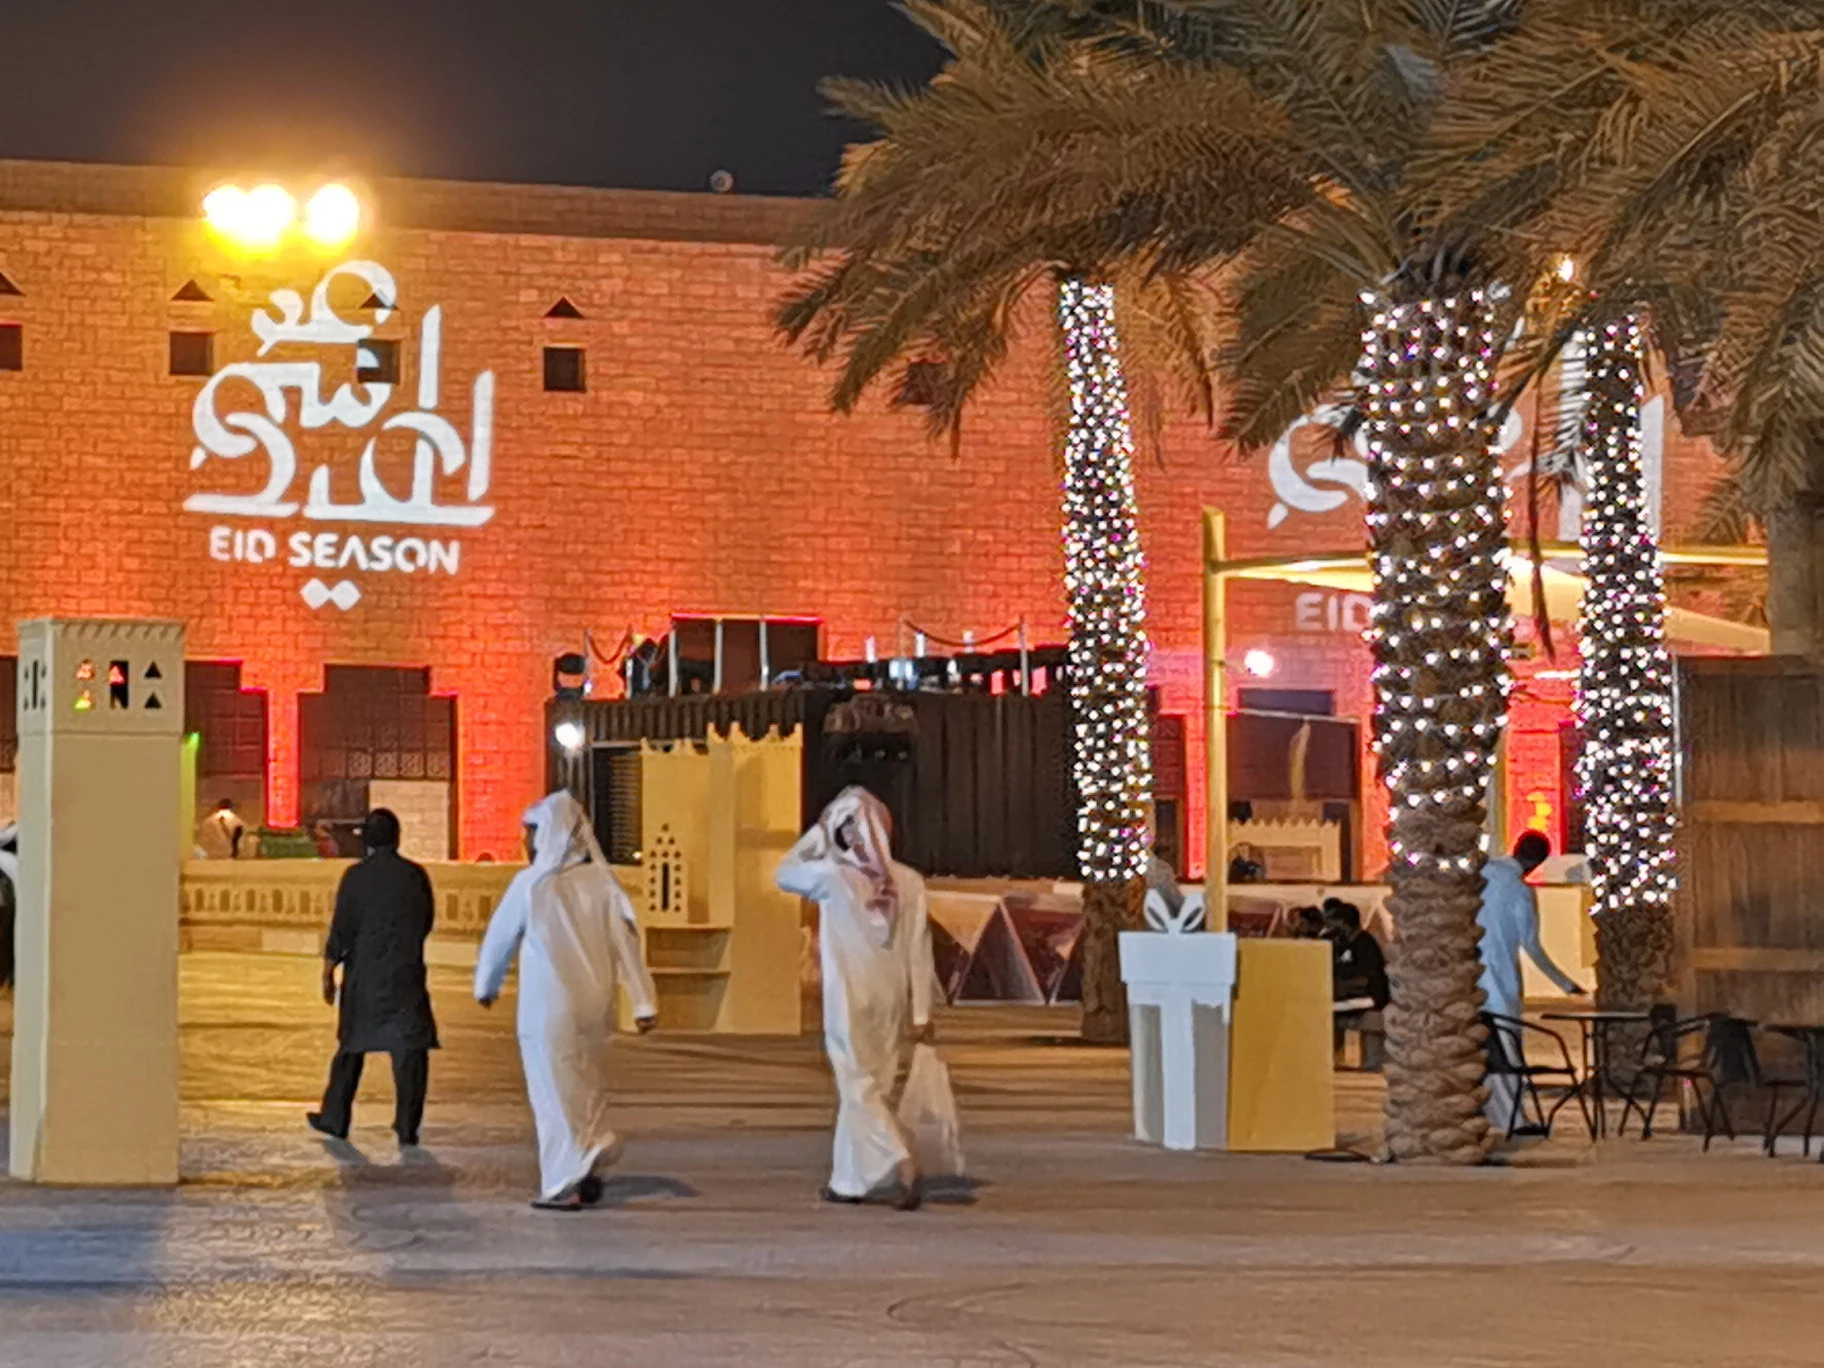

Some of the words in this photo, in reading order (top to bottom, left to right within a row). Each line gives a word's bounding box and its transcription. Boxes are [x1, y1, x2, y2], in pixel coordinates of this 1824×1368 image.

[209, 525, 276, 563] EID
[288, 530, 461, 576] SEASON
[1295, 592, 1375, 632] EID
